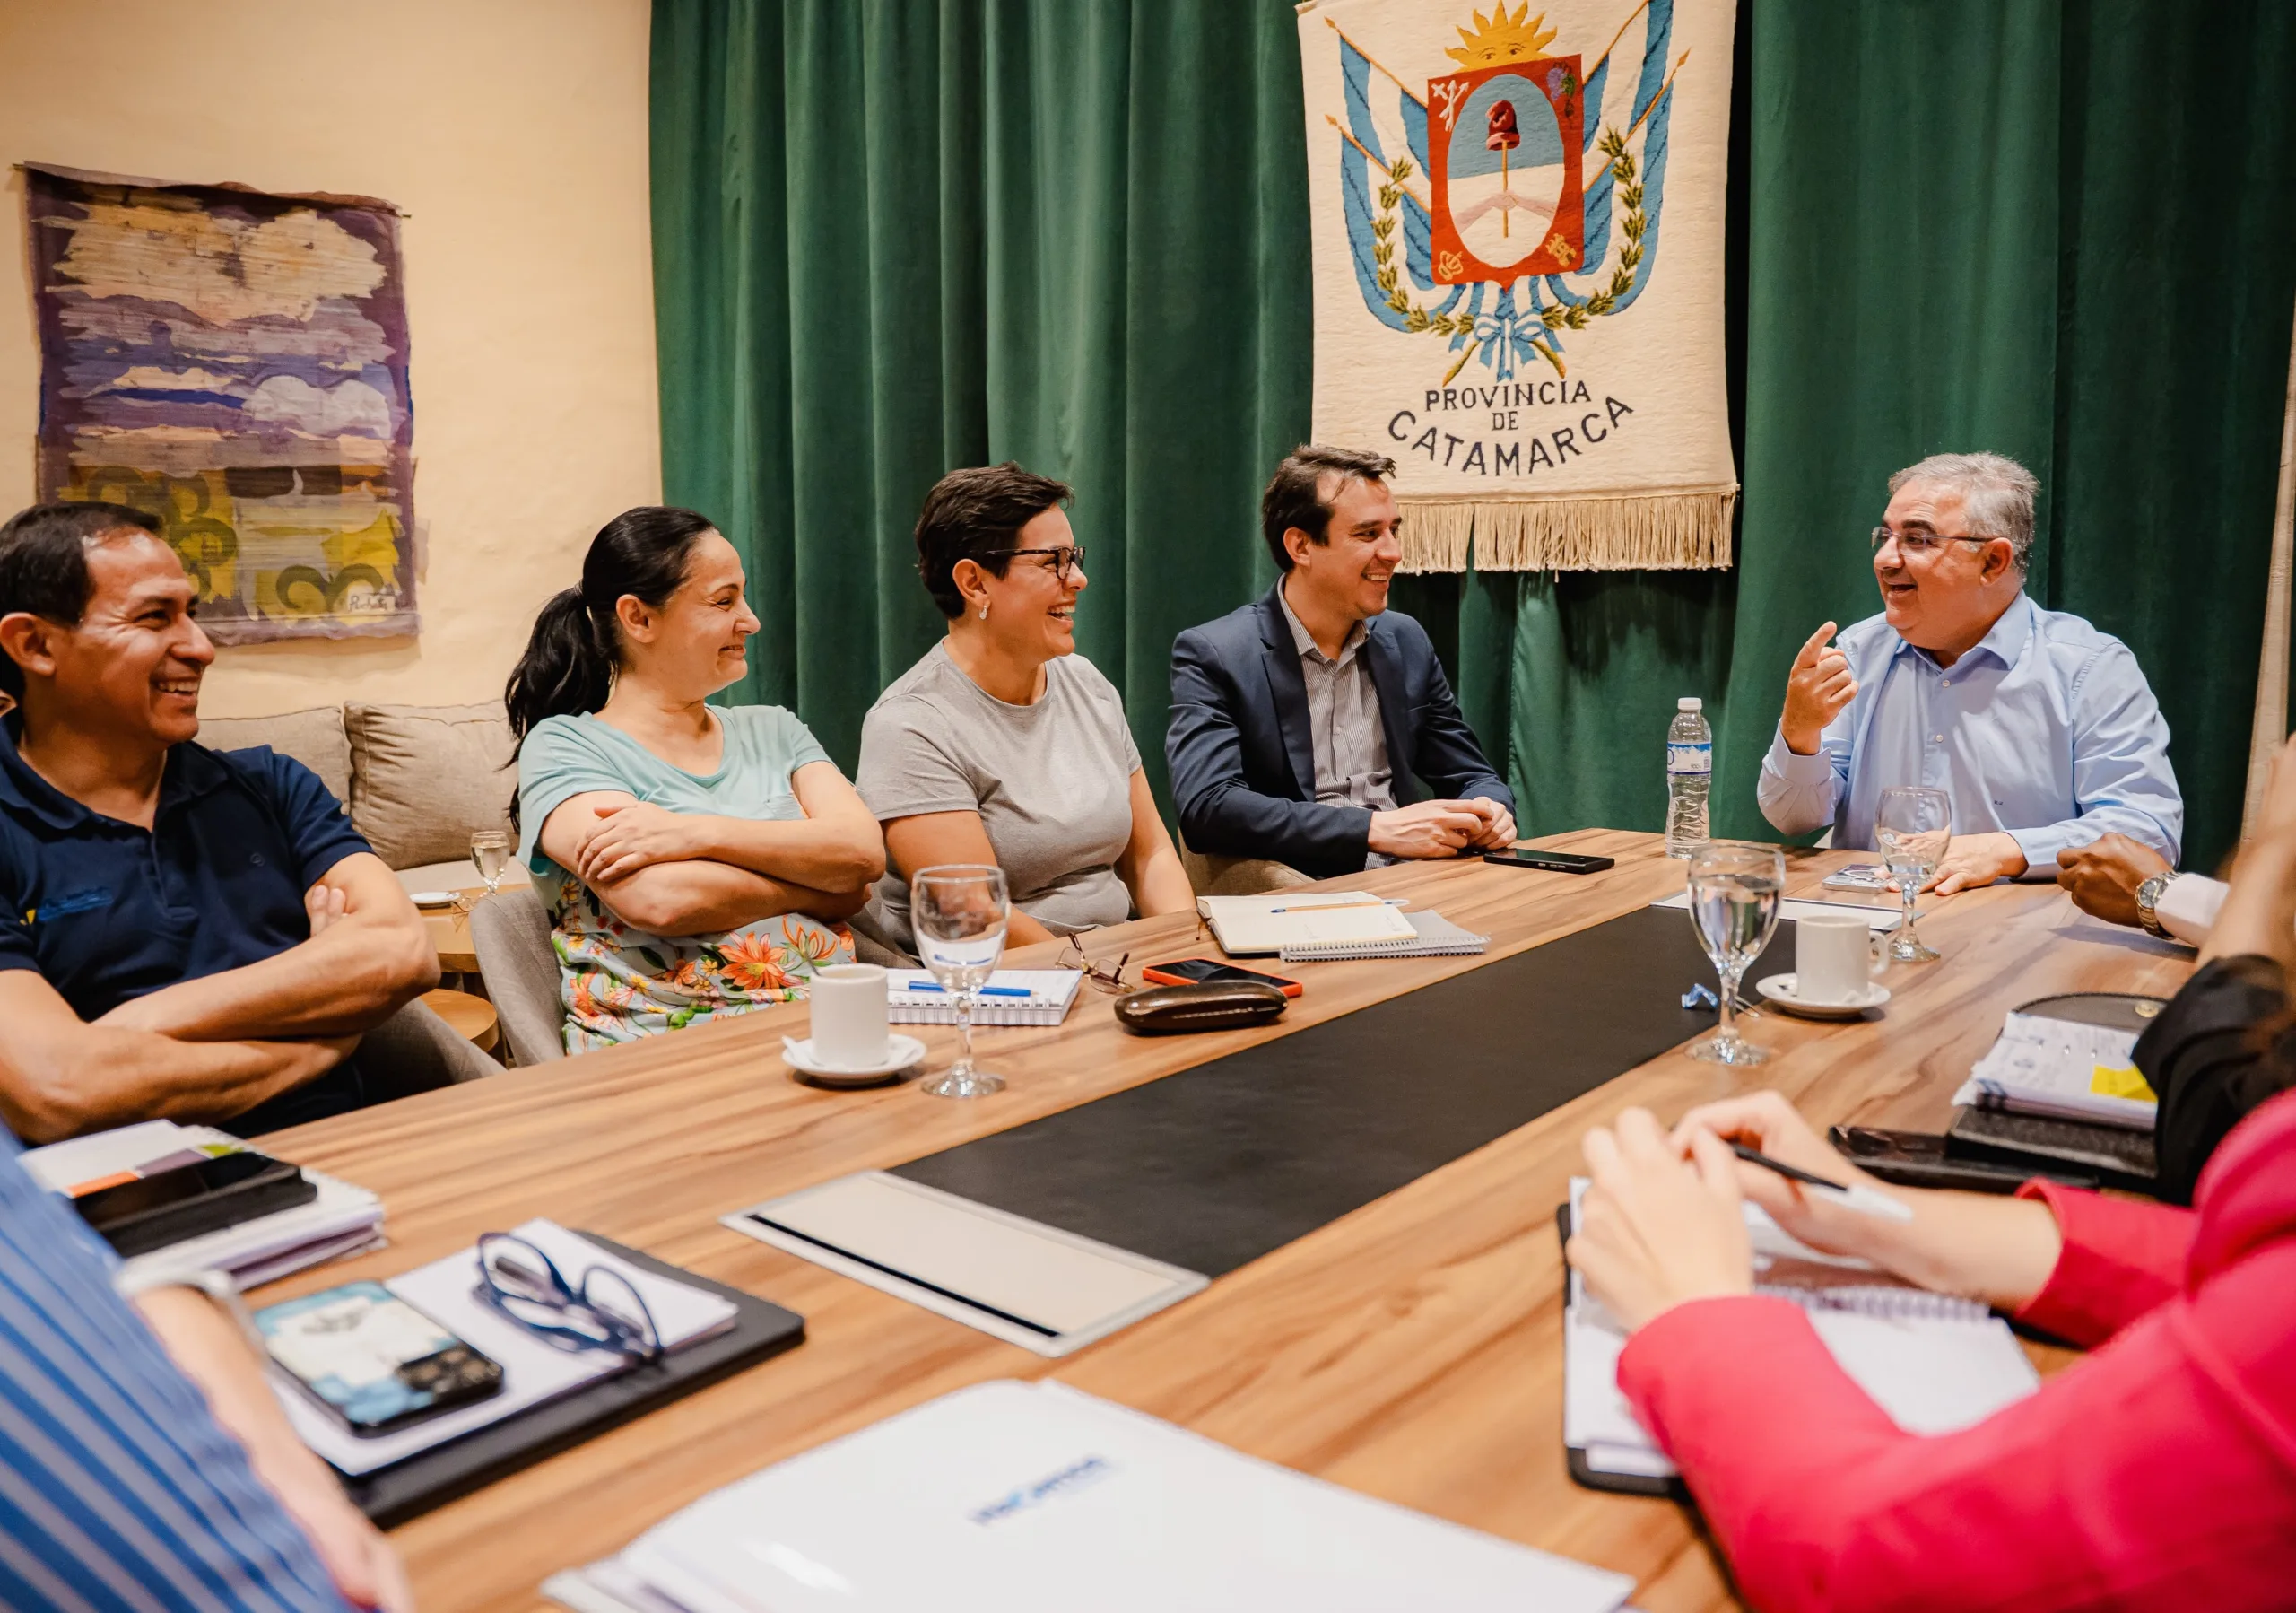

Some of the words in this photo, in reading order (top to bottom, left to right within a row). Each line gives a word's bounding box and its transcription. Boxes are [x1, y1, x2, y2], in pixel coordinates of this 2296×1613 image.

[1425, 380, 1592, 412] PROVINCIA
[1388, 396, 1634, 476] CATAMARCA
[1492, 411, 1519, 431] DE
